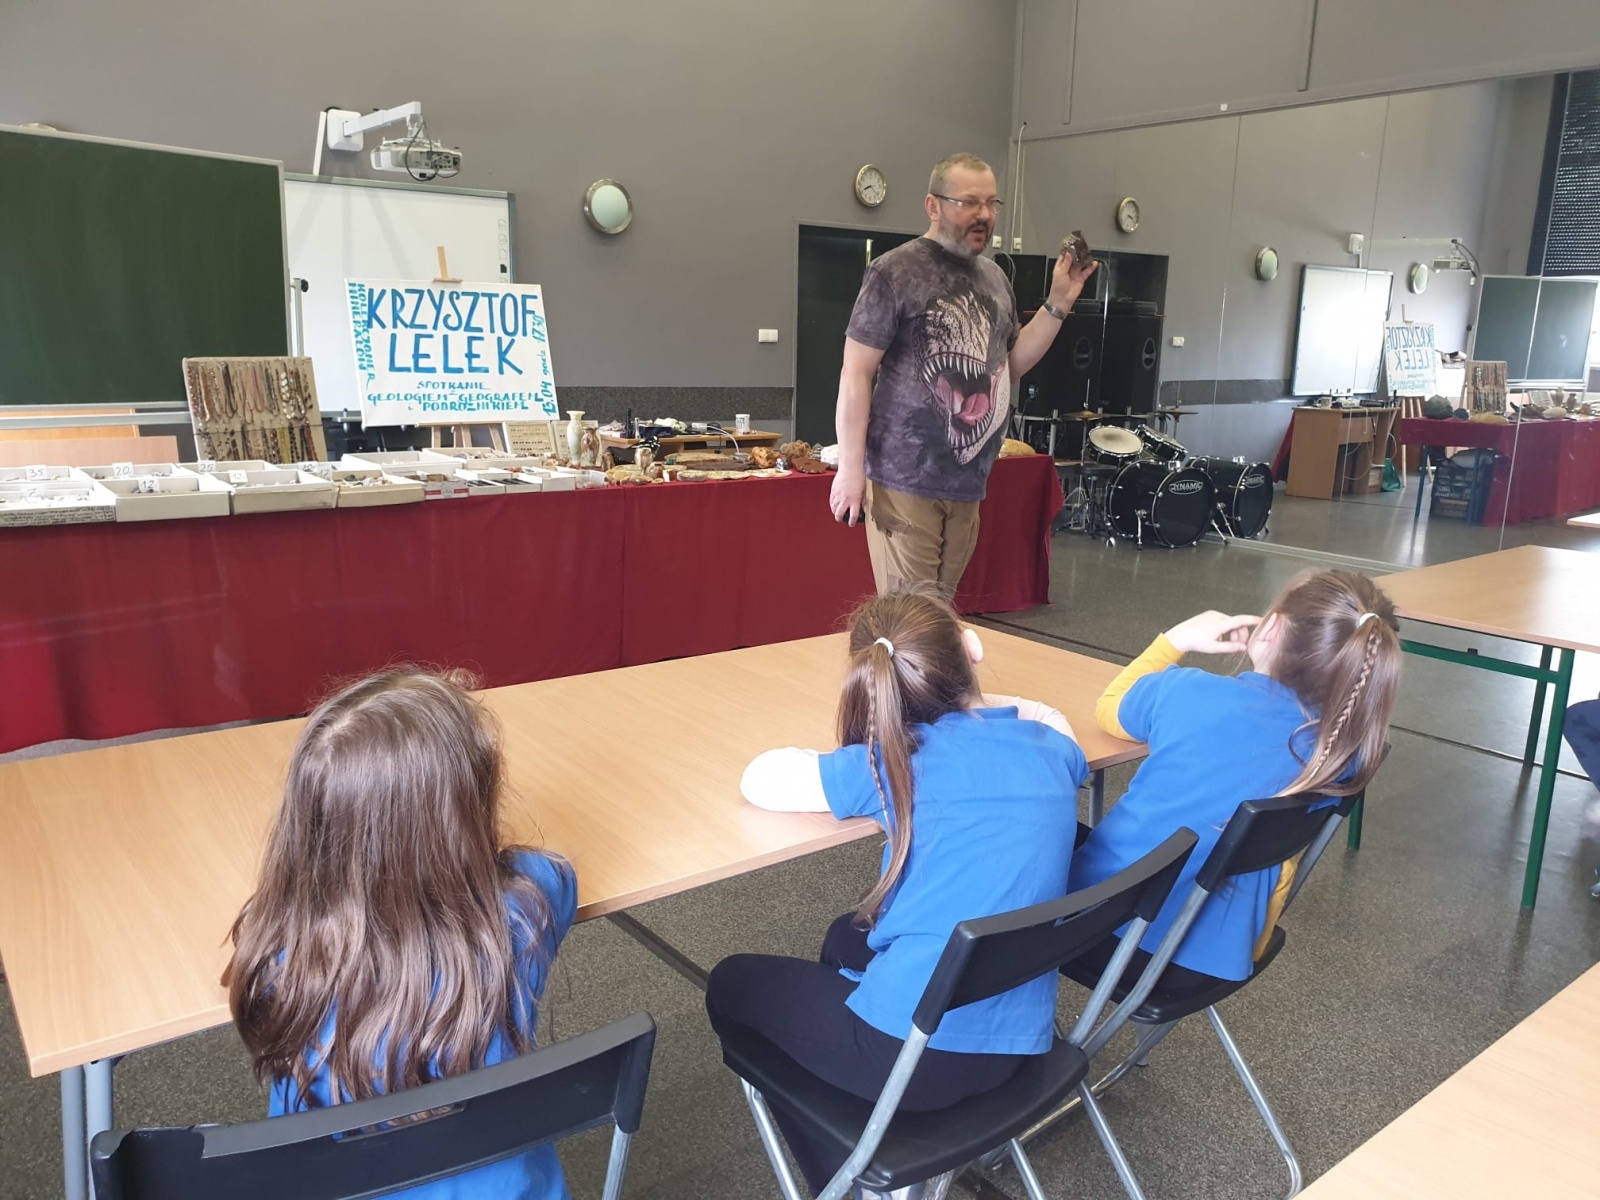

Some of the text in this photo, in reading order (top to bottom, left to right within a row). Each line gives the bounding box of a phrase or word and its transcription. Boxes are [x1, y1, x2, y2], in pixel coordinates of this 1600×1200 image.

[367, 288, 538, 337] KRZYSZTOF
[389, 333, 524, 376] LELEK
[417, 380, 488, 390] SPOTKANIE
[367, 392, 544, 406] GEOLOGIEM GEOGRAFEM
[28, 468, 45, 478] 35
